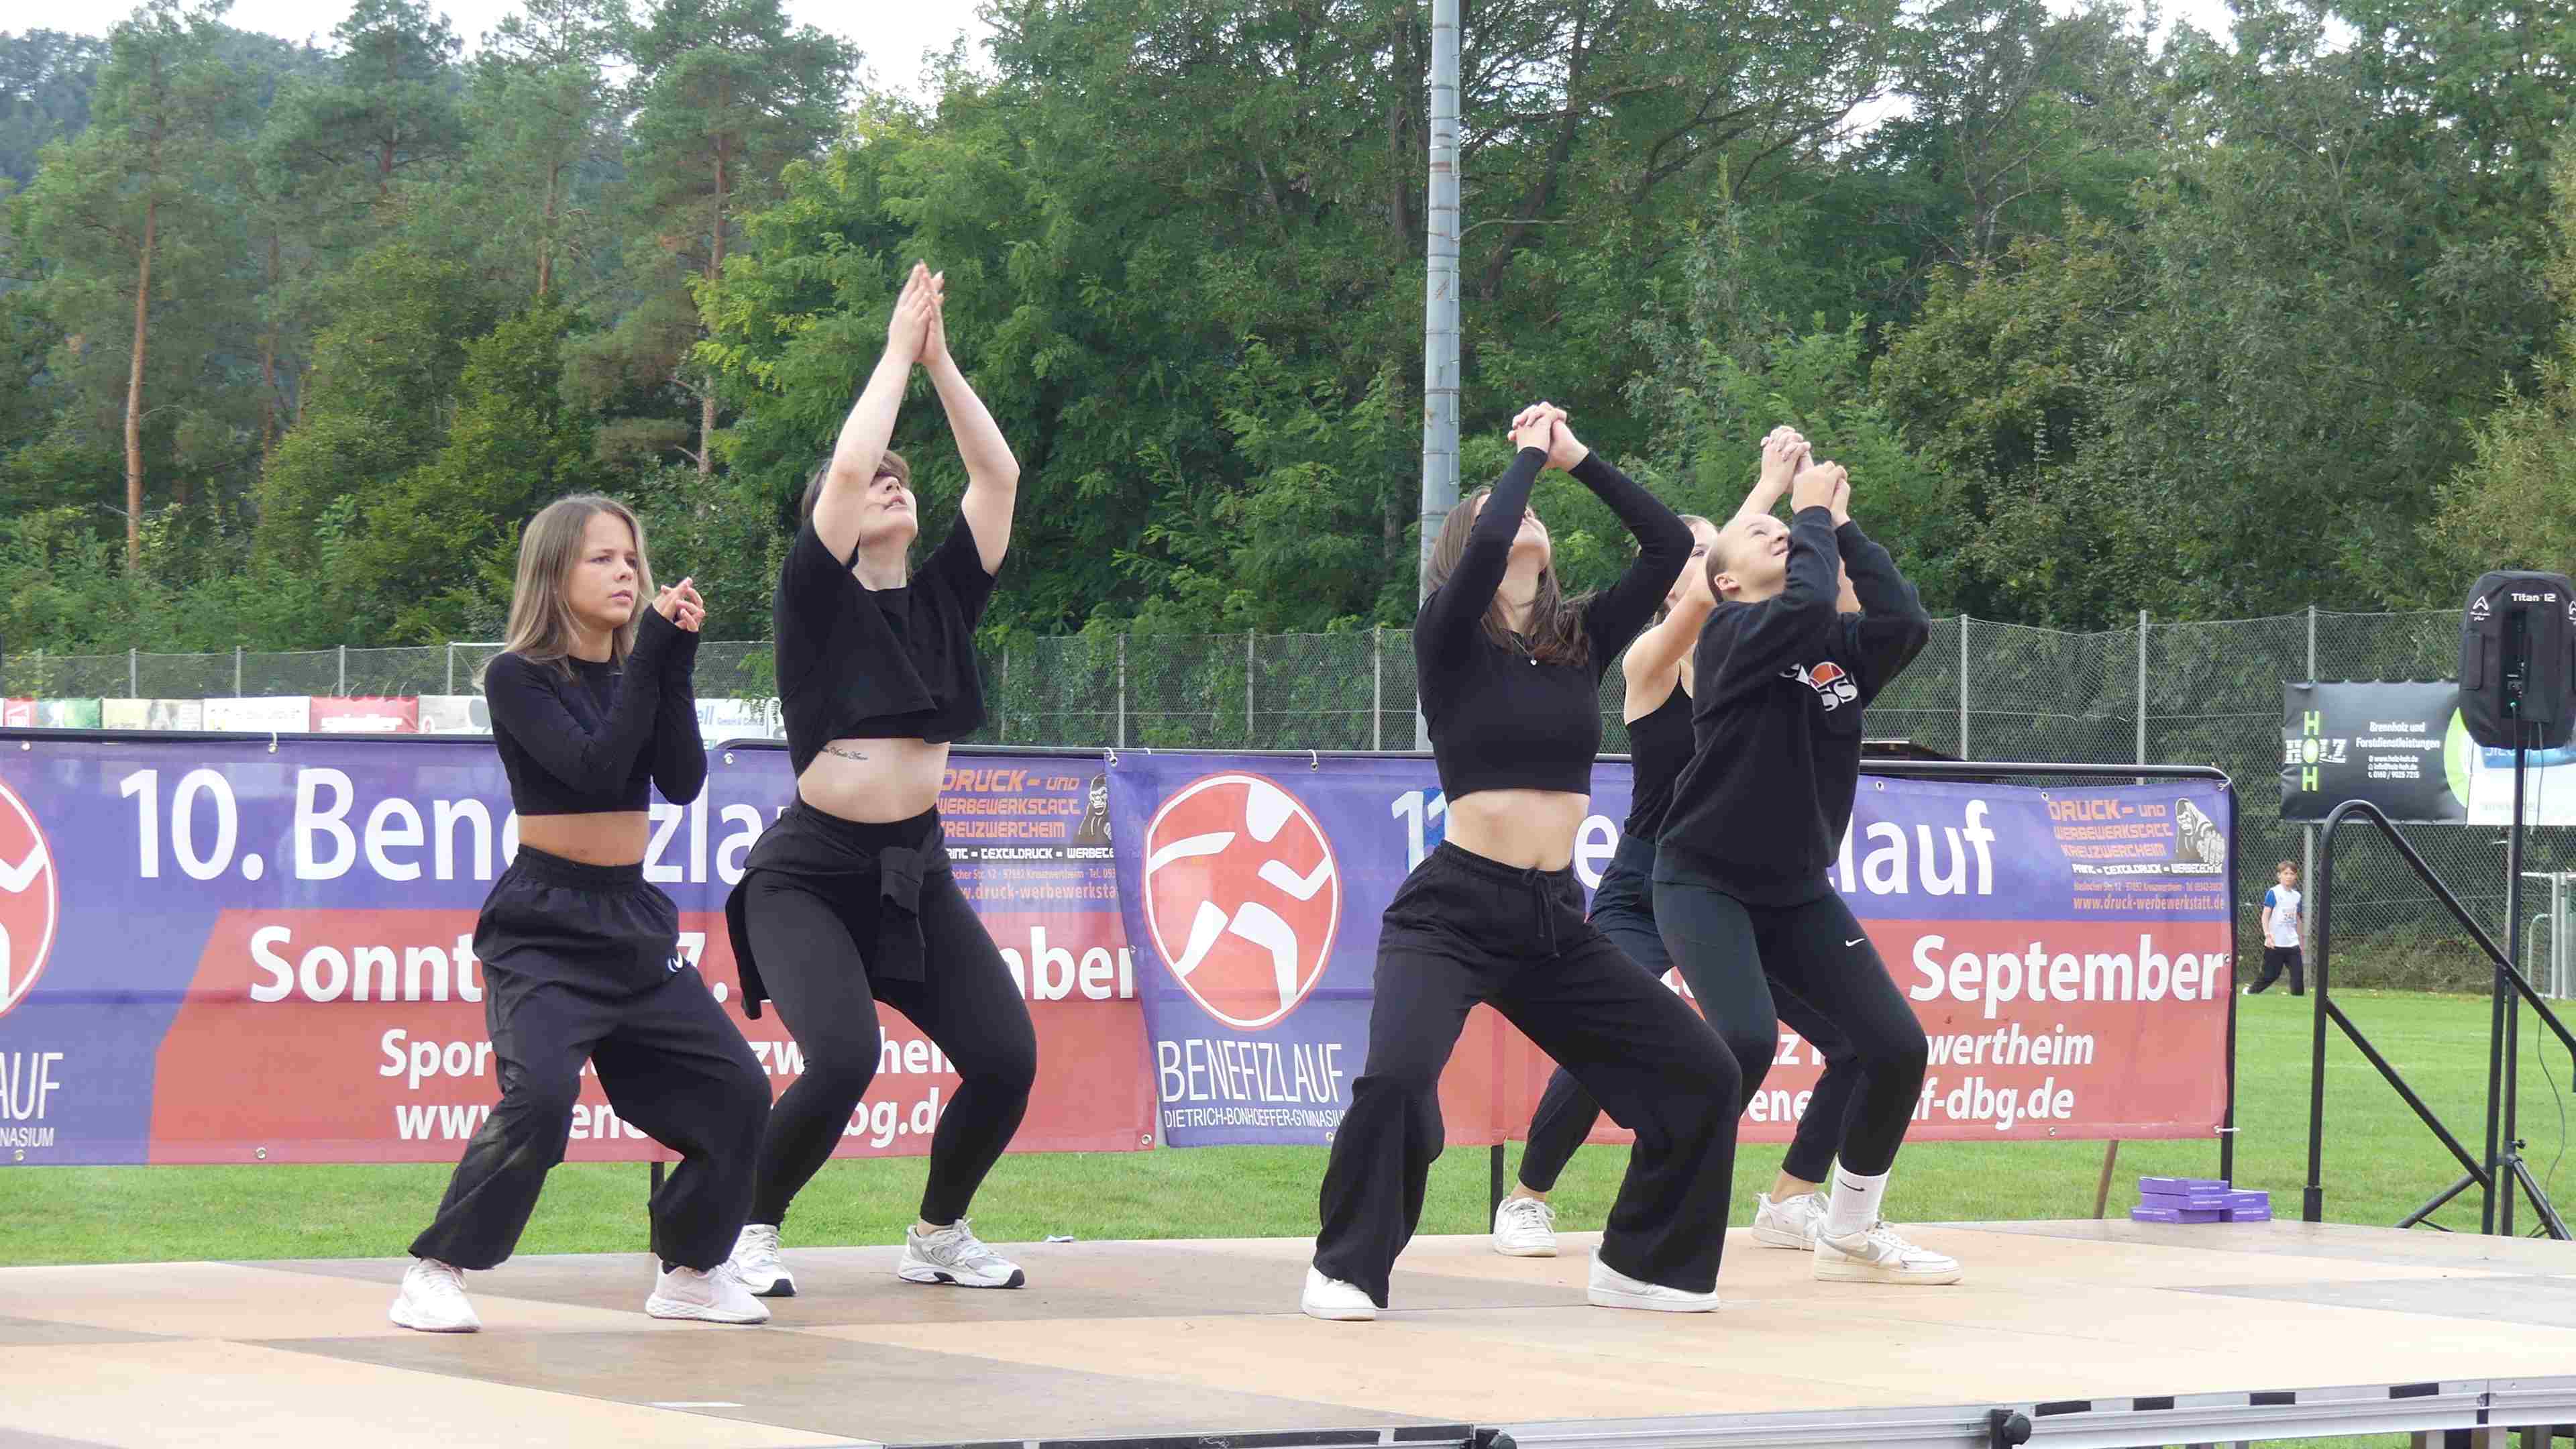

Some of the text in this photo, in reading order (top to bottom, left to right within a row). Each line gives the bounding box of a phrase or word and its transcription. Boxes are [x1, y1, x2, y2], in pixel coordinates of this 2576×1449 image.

[2511, 593, 2540, 602] Titan
[2356, 737, 2440, 750] Forstdienstleistungen
[2369, 721, 2426, 732] Brennholz und
[119, 768, 264, 881] 10.
[250, 926, 482, 1002] Sonnt
[1910, 934, 2224, 1019] September
[1925, 1023, 2094, 1065] wertheim
[1158, 1039, 1343, 1103] BENEFIZLAUF
[1165, 1108, 1345, 1128] DIETRICH-BONHOEFFER-GYMNASIU
